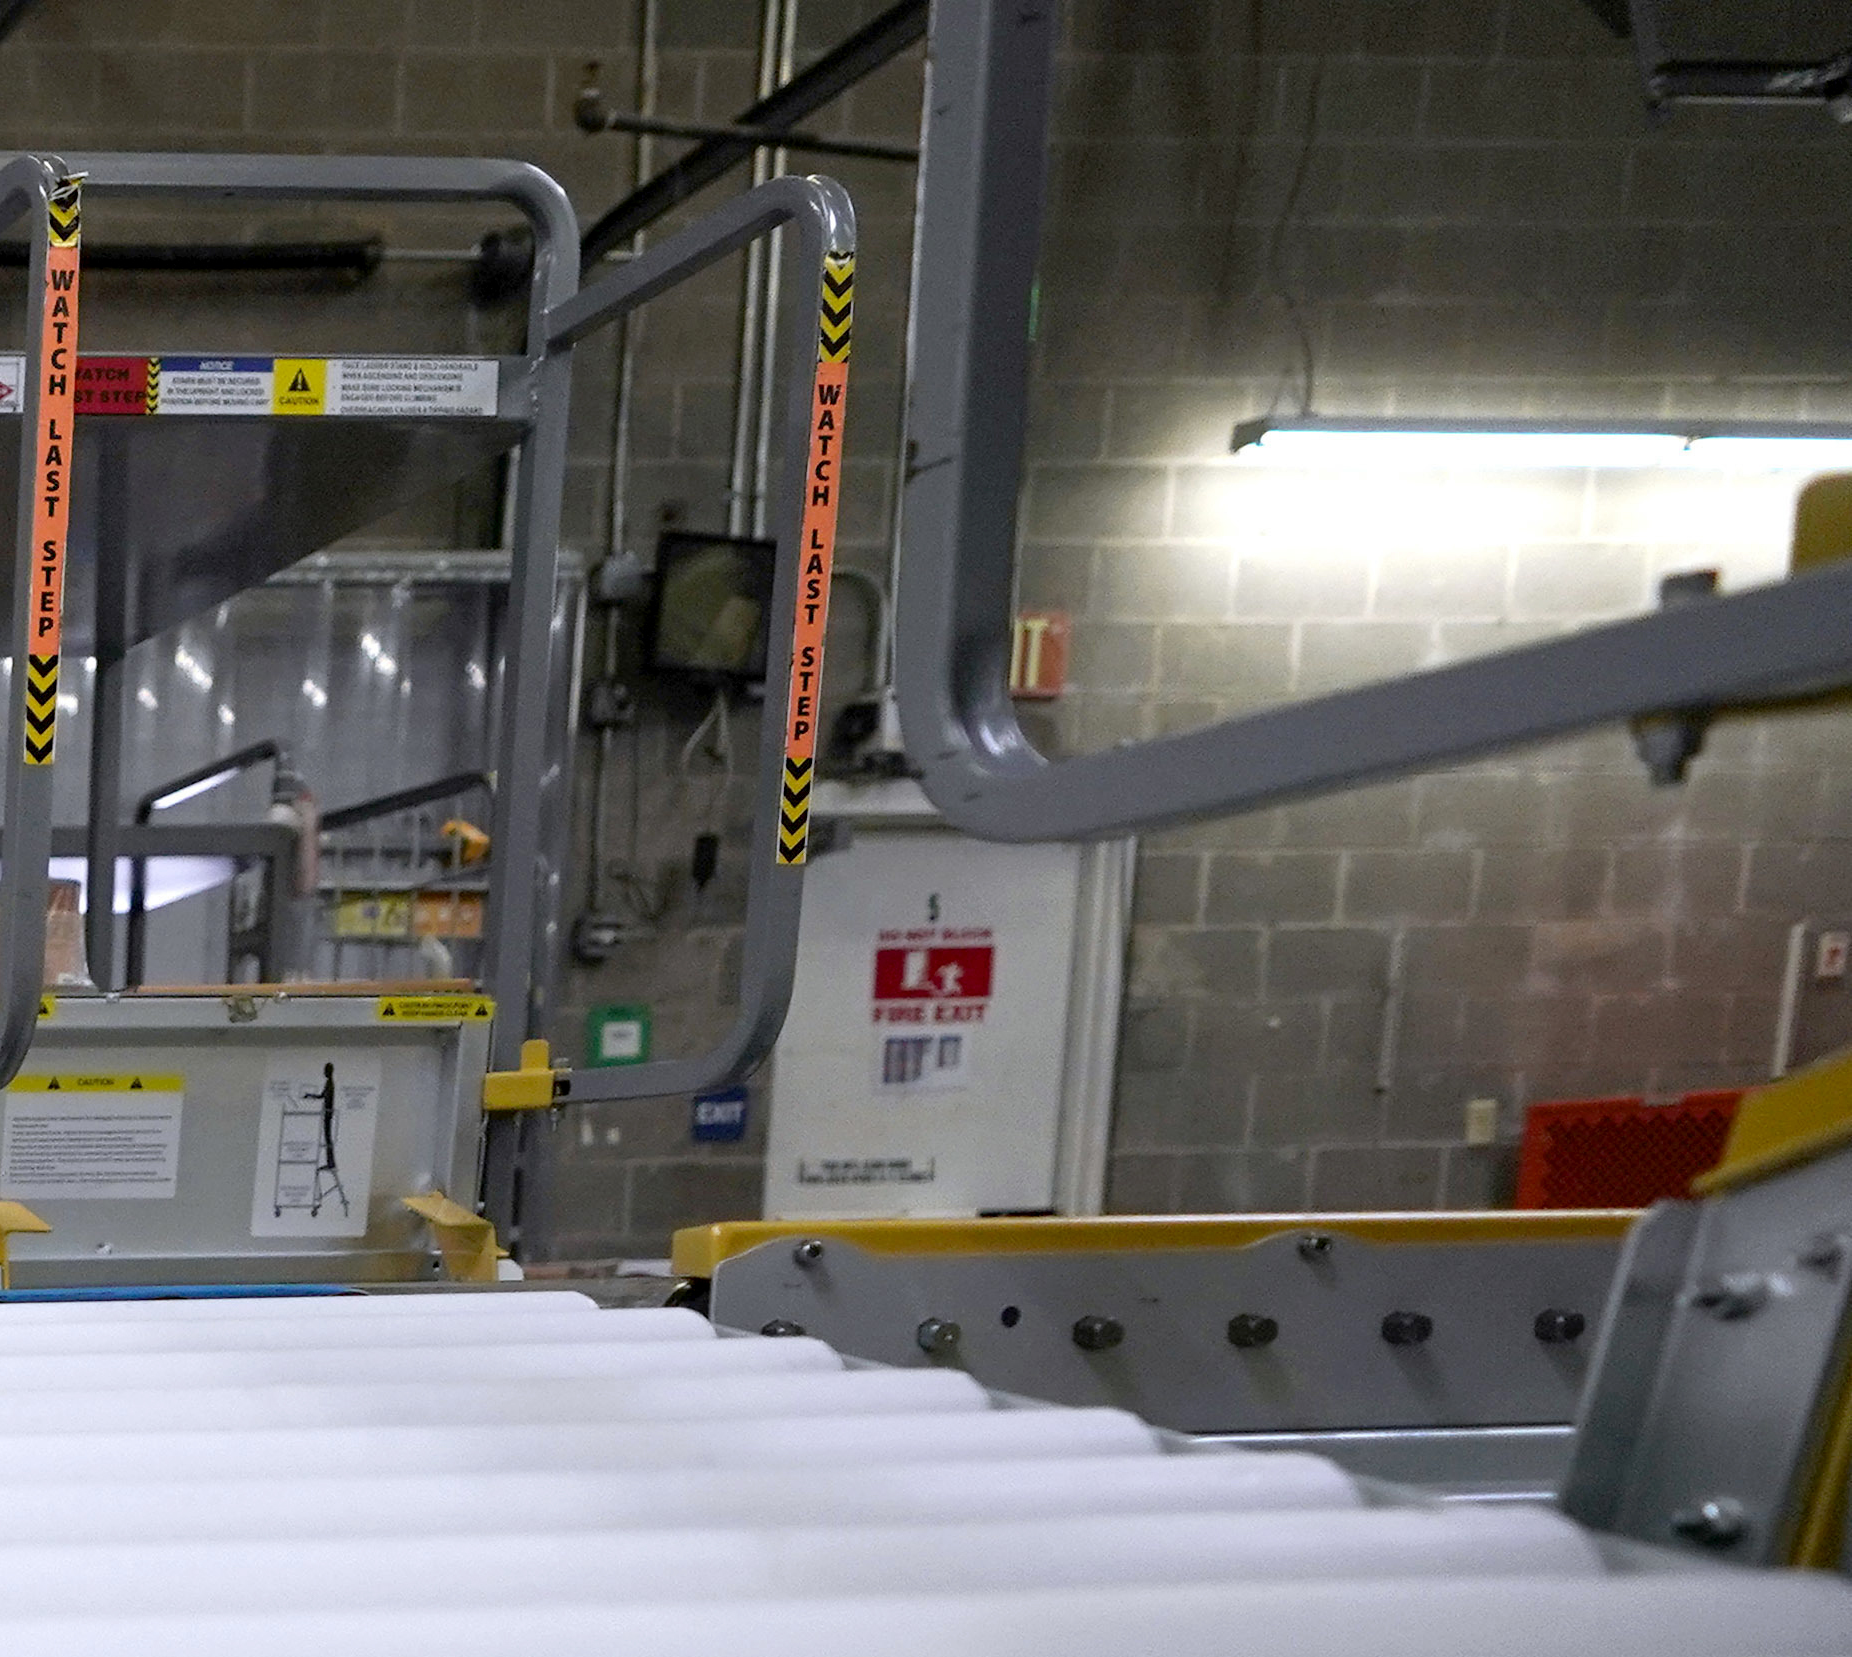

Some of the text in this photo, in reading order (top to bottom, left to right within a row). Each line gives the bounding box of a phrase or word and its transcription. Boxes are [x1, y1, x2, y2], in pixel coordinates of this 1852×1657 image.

[76, 367, 129, 380] ATCH
[279, 397, 319, 406] CAUTION
[38, 270, 75, 638] WATCH LAST STEP
[794, 384, 841, 741] WATCH LAST STEP
[872, 1005, 985, 1023] FIRE EXIT
[77, 1078, 114, 1087] CAUTION
